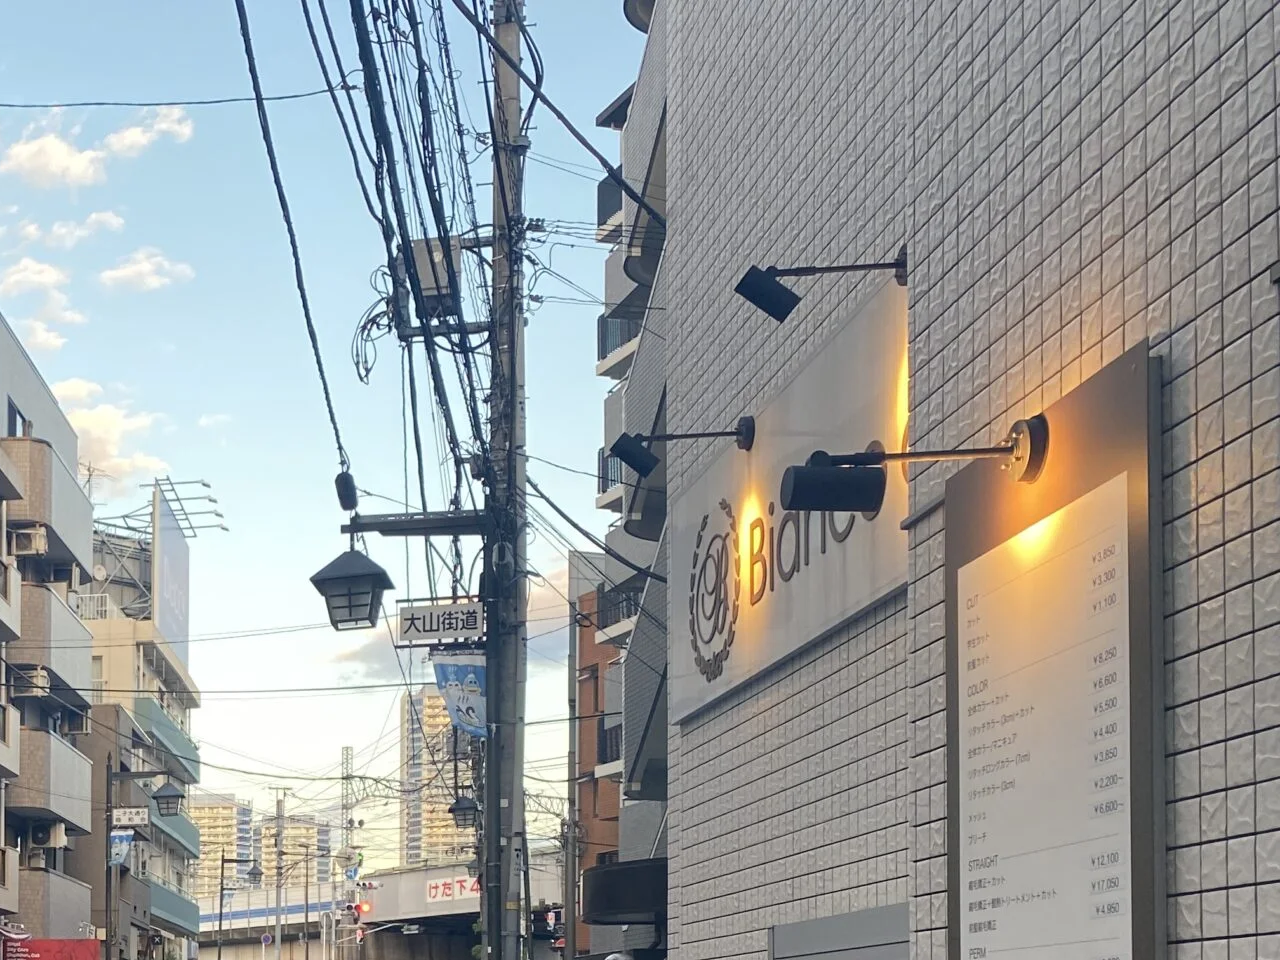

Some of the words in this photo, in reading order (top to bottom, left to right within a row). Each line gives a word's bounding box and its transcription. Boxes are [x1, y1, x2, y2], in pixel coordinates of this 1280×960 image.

[749, 440, 887, 607] Bian
[403, 609, 479, 635] 大山街道
[967, 678, 989, 698] COLOR
[967, 854, 999, 873] STRAIGHT
[968, 947, 987, 960] PERM
